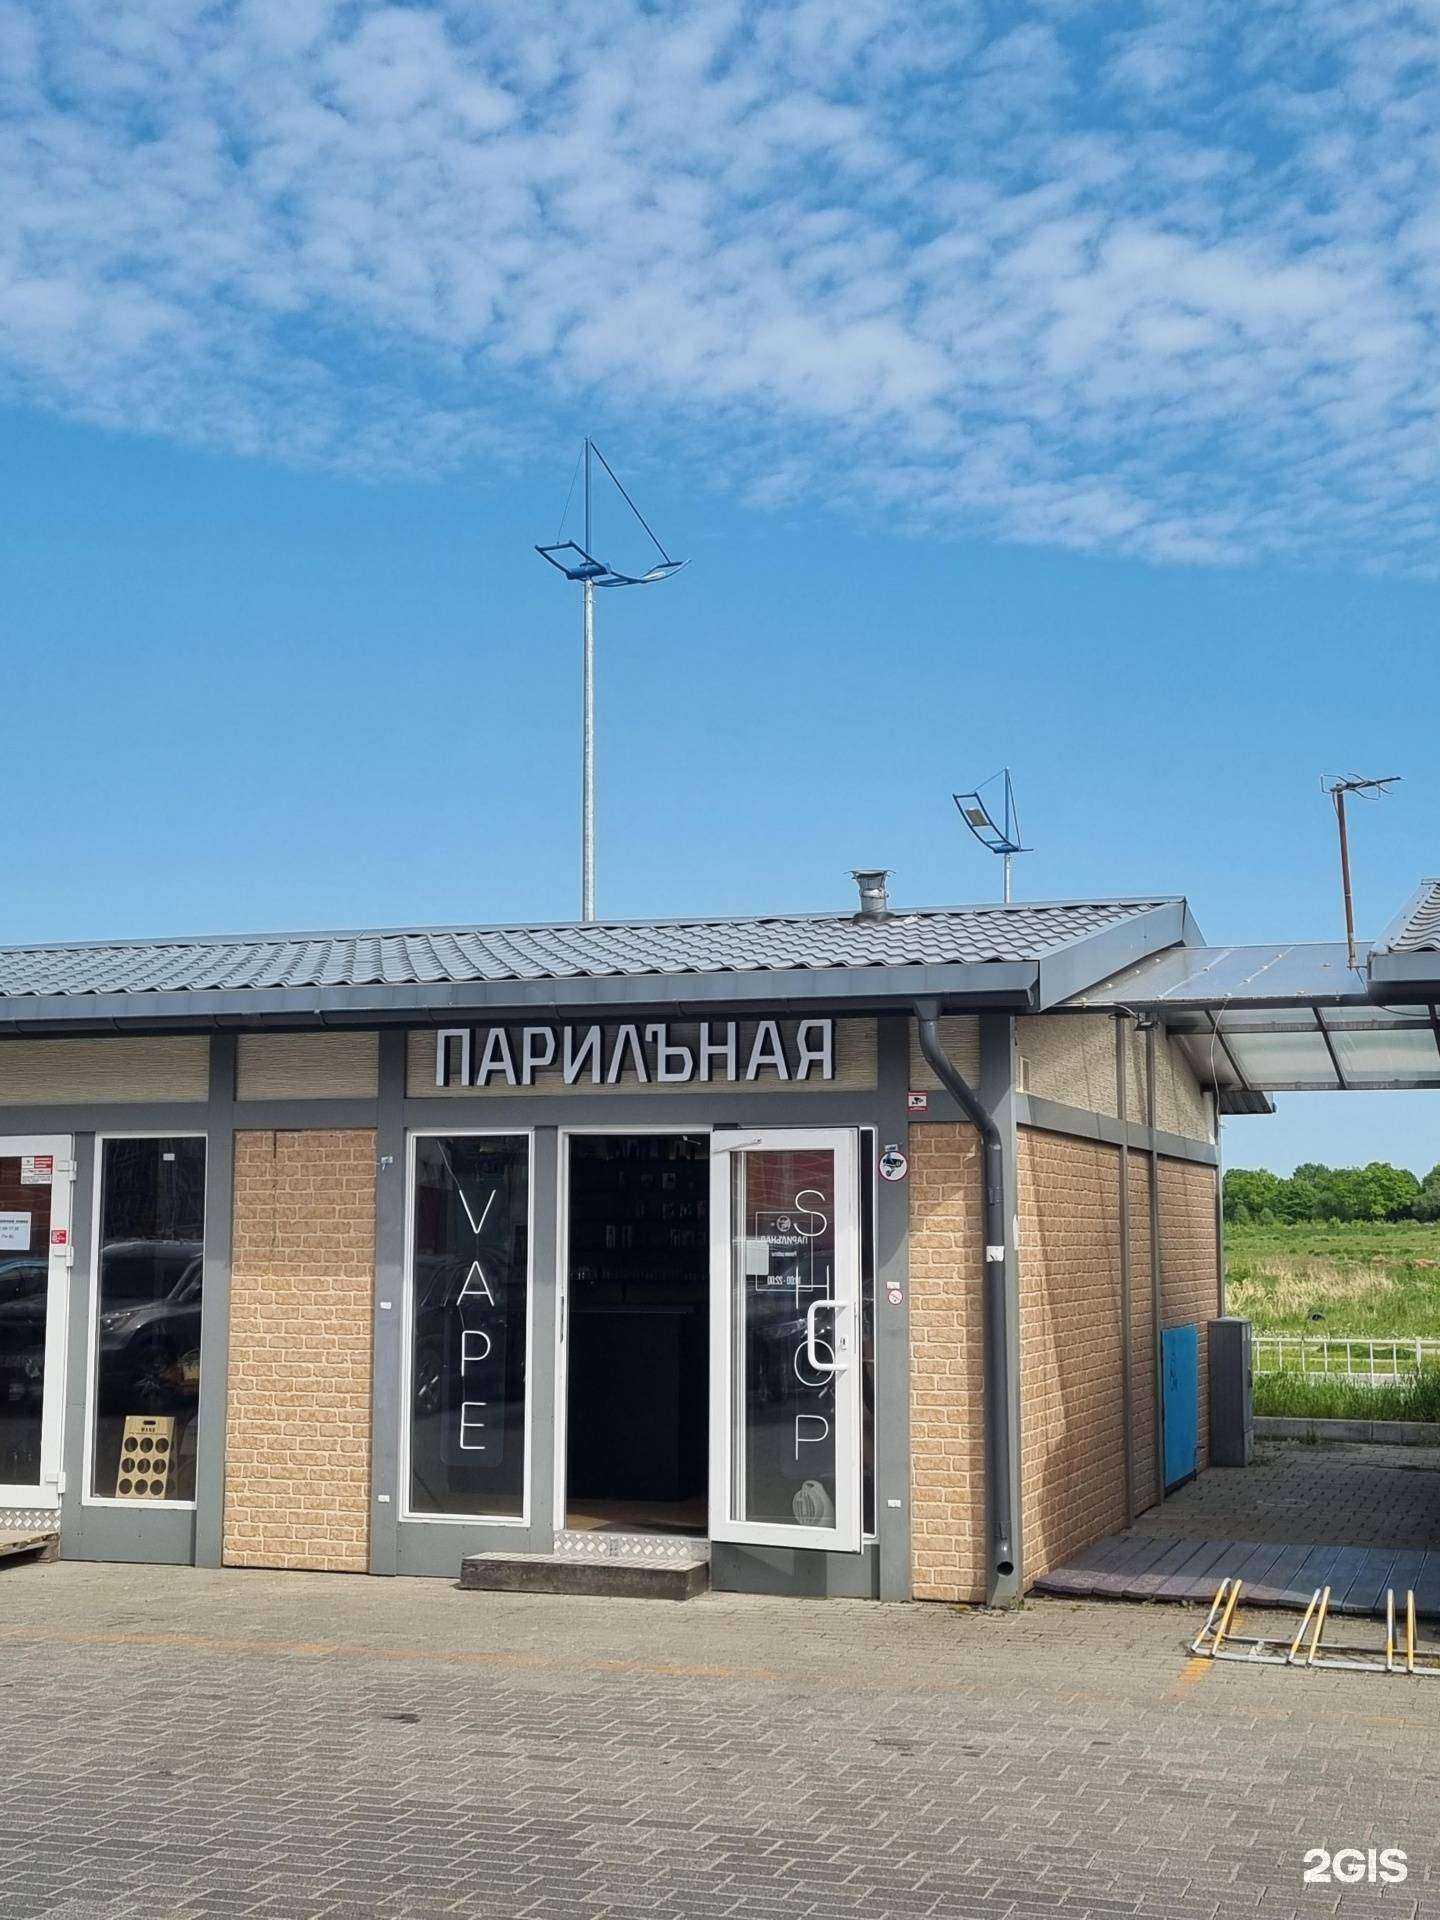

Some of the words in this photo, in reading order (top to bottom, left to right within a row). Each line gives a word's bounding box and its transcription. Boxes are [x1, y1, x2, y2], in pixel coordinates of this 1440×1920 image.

[436, 1018, 832, 1086] ПАРИЛЪНАЯ
[456, 1189, 496, 1450] VAPE
[793, 1190, 835, 1461] SHOP
